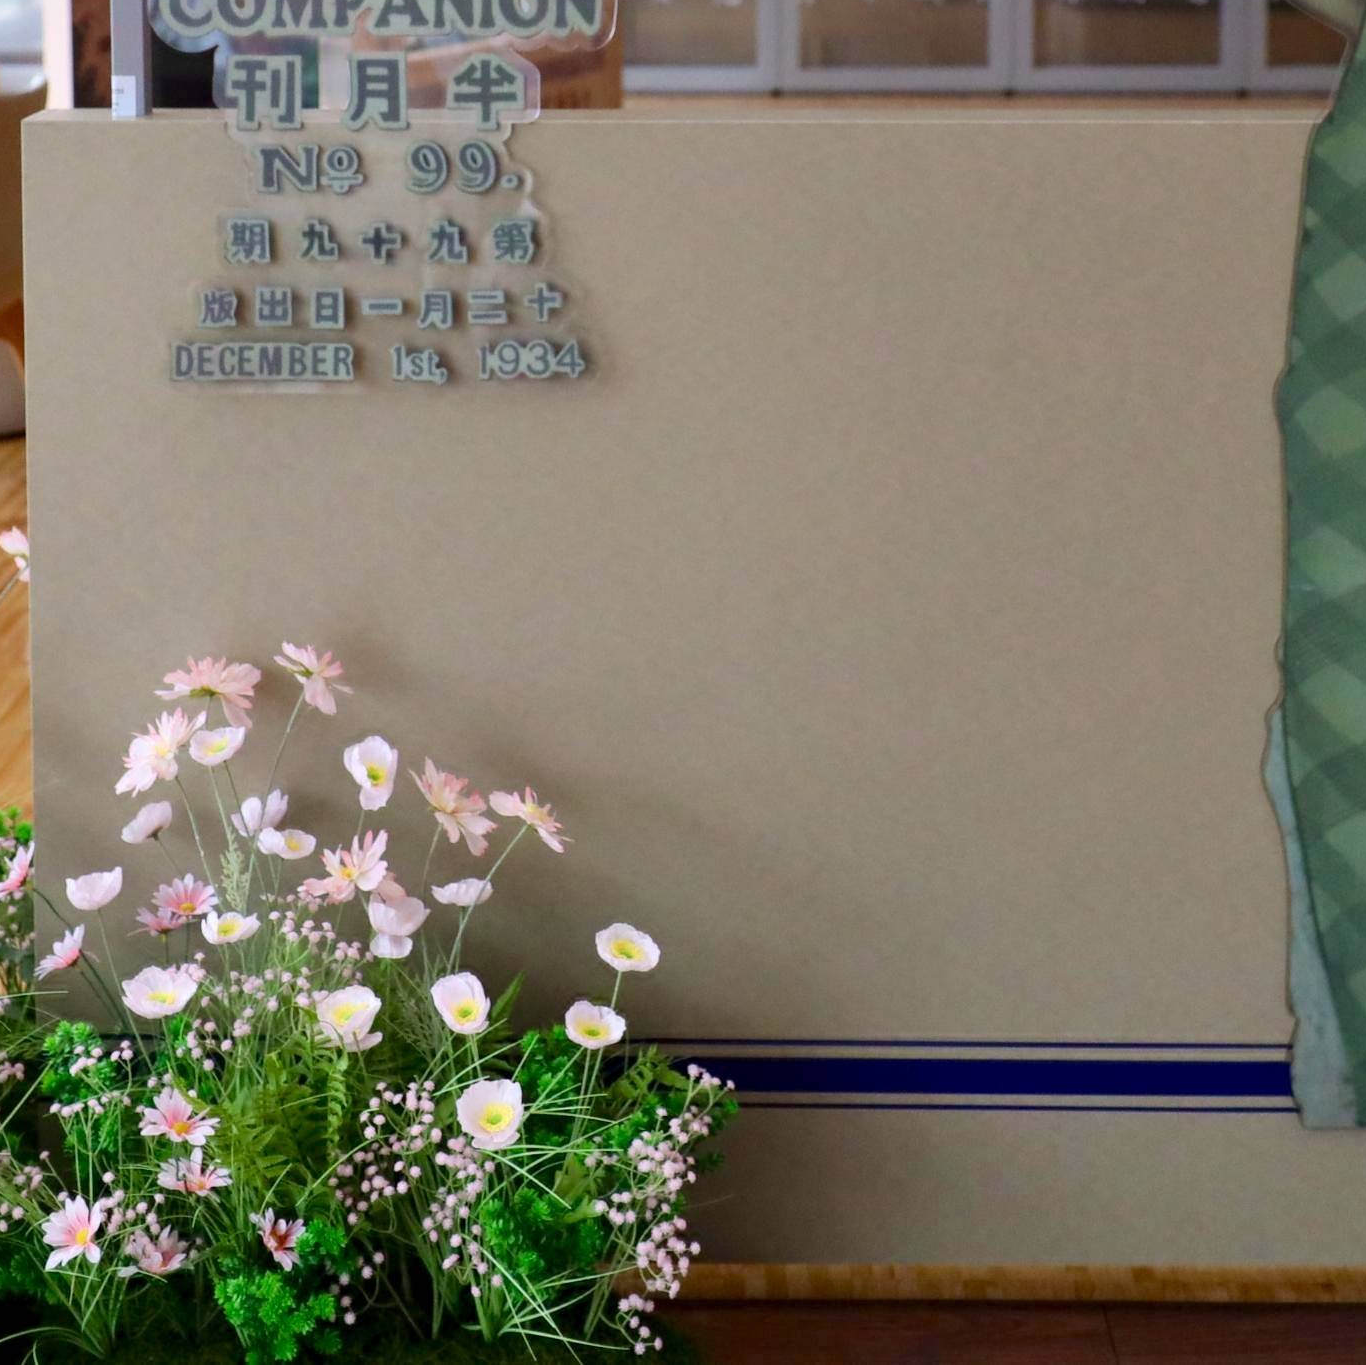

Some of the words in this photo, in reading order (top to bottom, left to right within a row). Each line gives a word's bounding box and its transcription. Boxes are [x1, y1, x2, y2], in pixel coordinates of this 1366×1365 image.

[174, 344, 354, 379] DECEMBER
[392, 345, 447, 382] 1st,
[479, 342, 582, 377] 1934
